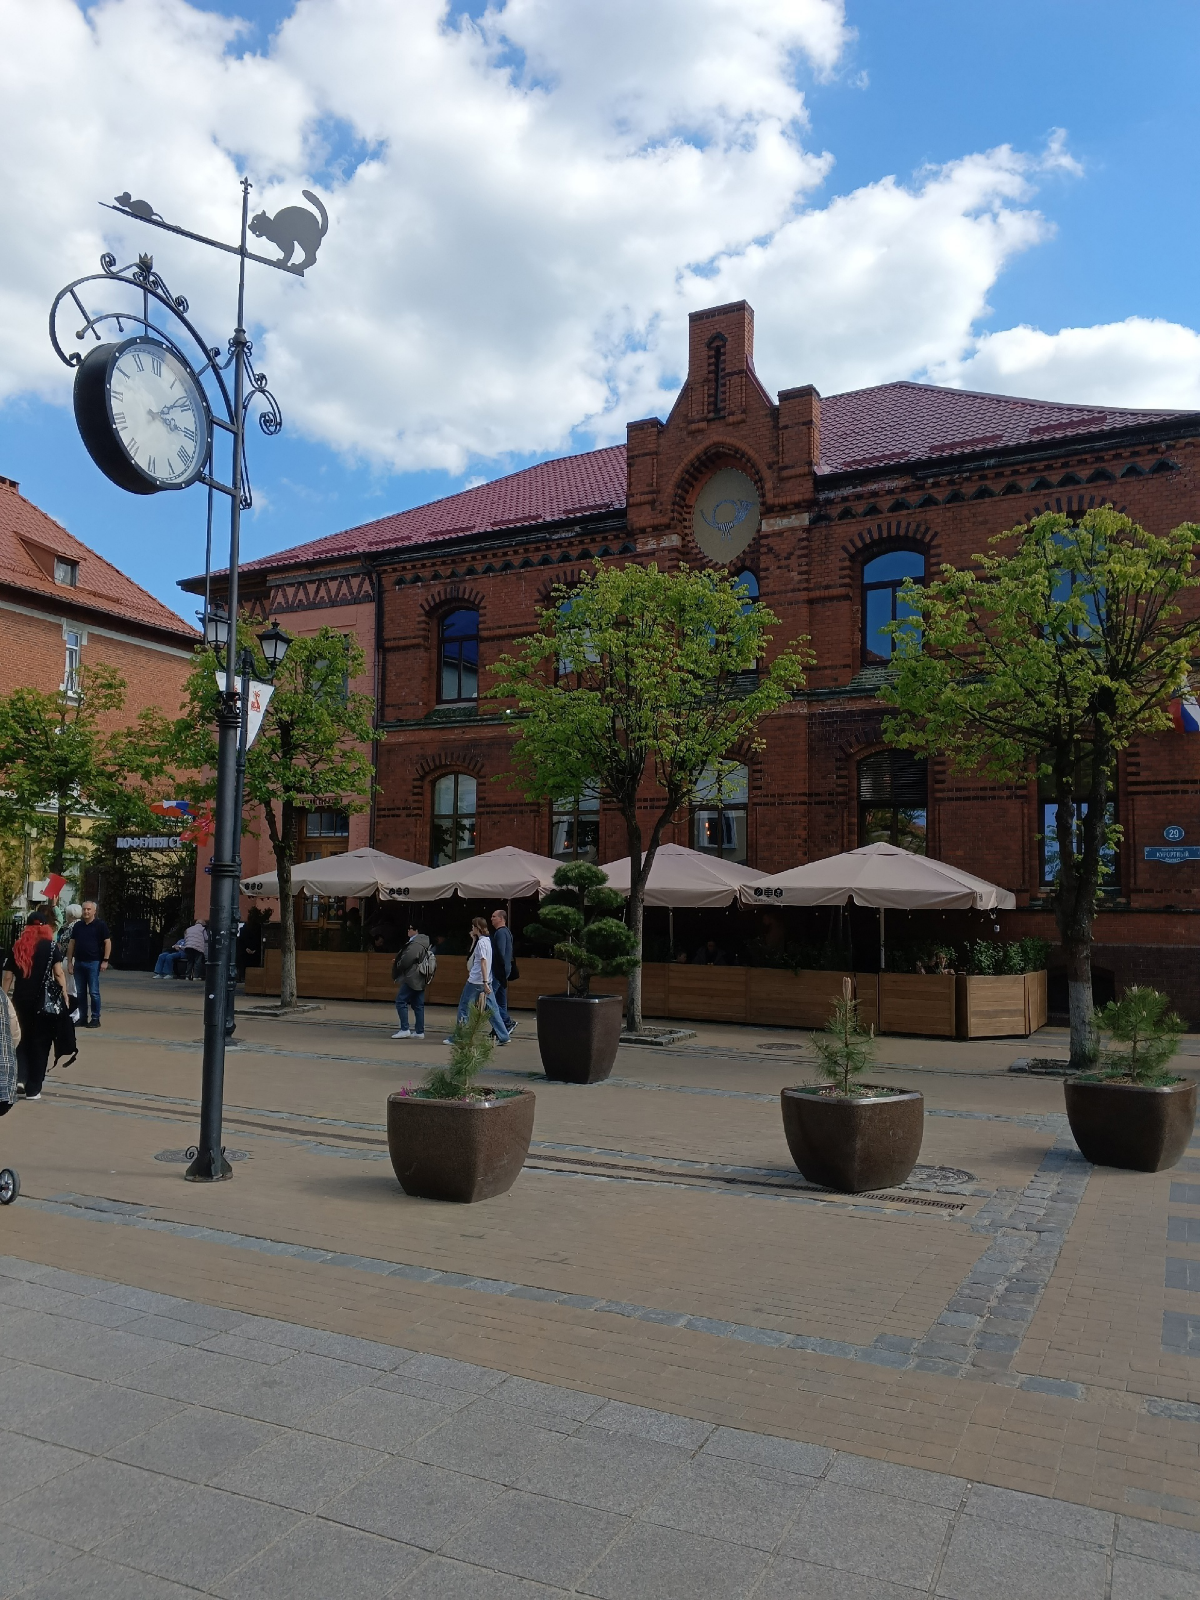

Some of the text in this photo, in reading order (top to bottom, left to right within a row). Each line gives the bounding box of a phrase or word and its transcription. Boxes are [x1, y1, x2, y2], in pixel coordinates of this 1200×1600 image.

[132, 354, 144, 373] XI
[151, 357, 162, 378] XII
[170, 378, 177, 390] I
[183, 427, 195, 442] III
[177, 445, 191, 466] IIII
[147, 455, 156, 474] VI
[167, 458, 175, 475] V
[116, 834, 168, 849] КОФЕЙНЯ
[1169, 829, 1179, 838] 29
